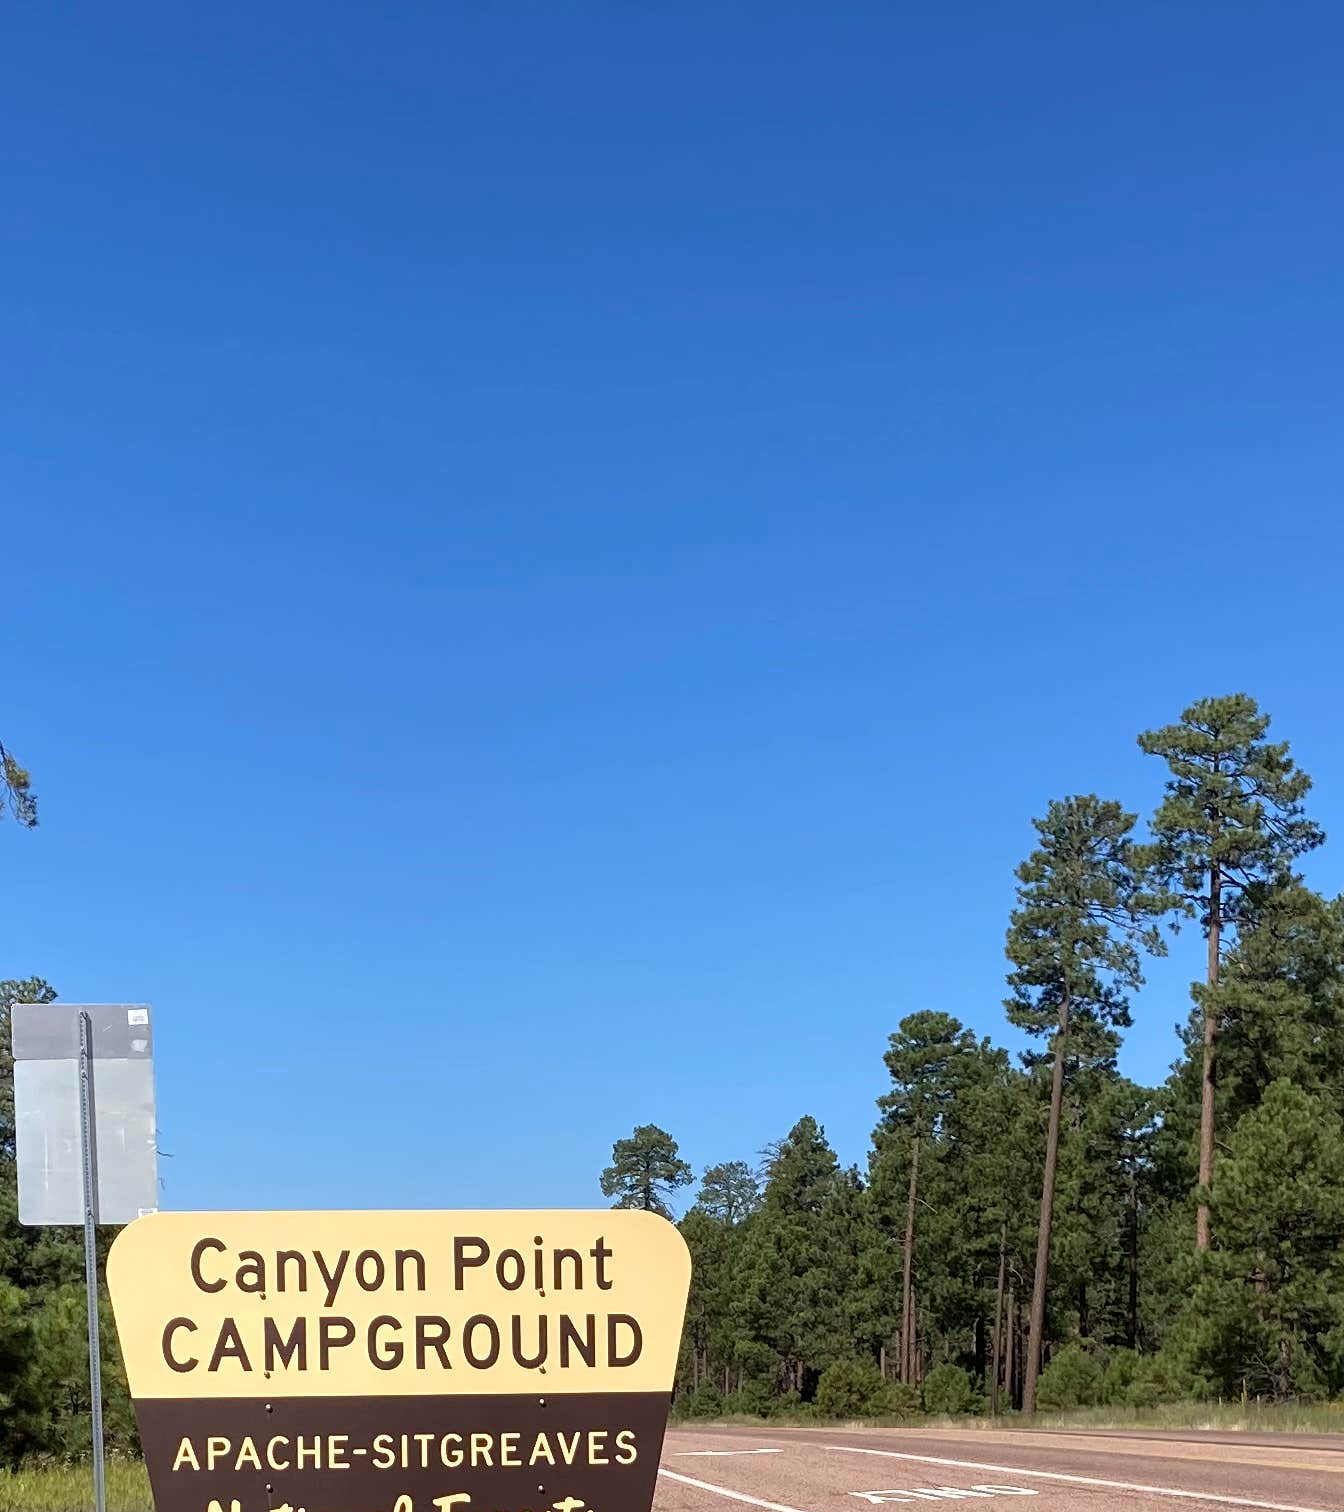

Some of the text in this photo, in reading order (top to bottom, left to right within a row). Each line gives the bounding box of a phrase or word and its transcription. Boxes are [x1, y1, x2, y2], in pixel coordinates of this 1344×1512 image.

[191, 1235, 613, 1307] Canyon Point
[162, 1314, 643, 1373] CAMPGROUND
[172, 1431, 637, 1472] APACHE-SITGREAVES
